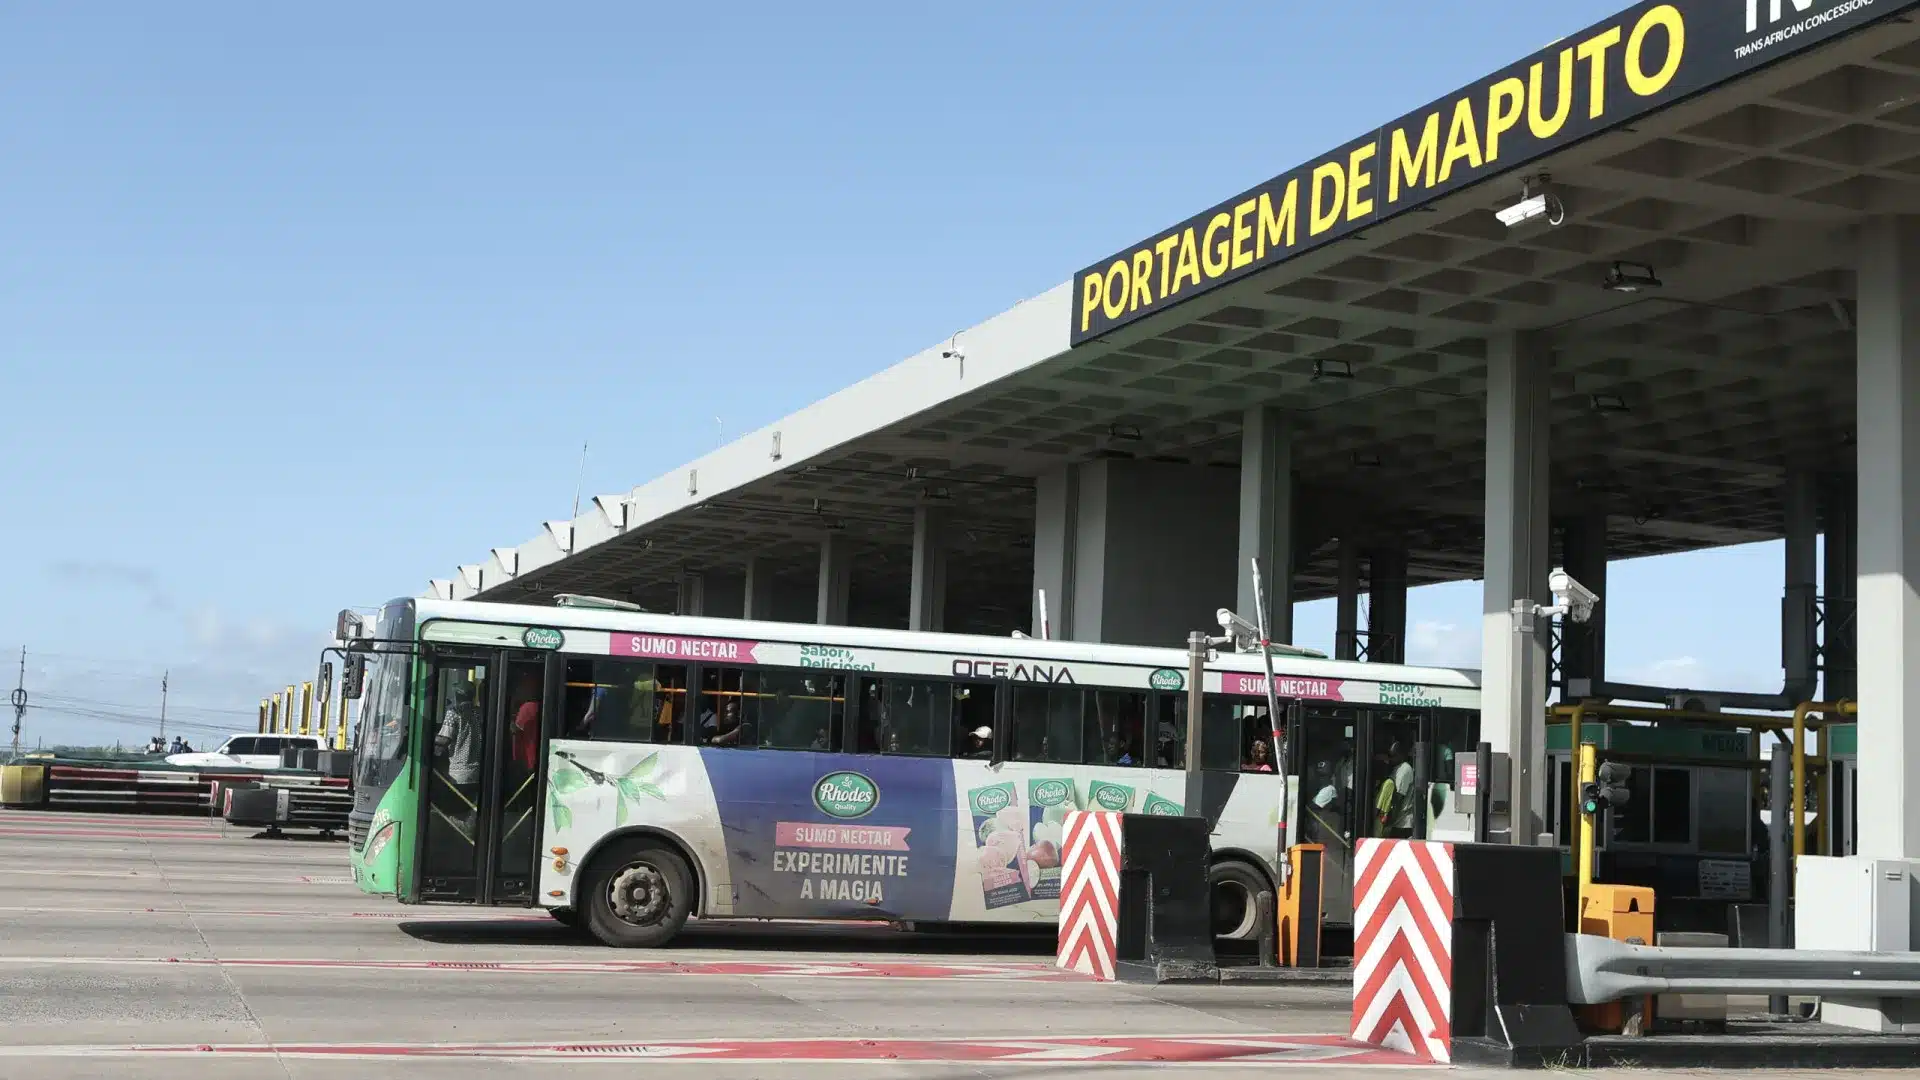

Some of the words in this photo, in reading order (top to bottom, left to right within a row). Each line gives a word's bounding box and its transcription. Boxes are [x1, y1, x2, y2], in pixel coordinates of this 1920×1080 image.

[1734, 38, 1764, 60] TRANS
[1763, 21, 1804, 48] AFRICAN
[1081, 181, 1297, 333] PORTAGEM
[1308, 142, 1376, 237] DE
[1388, 4, 1686, 203] MAPUTO
[526, 631, 560, 644] Rhodes
[631, 636, 676, 655] SUMO
[681, 640, 738, 659] NECTAR
[800, 644, 844, 658] Sabor
[800, 656, 876, 672] Delicioso!
[952, 659, 1076, 684] OCEANA
[1152, 674, 1181, 685] Rhodes
[1239, 677, 1276, 693] SUM
[1280, 680, 1328, 696] NECTAR
[1379, 682, 1416, 693] Sabor
[1379, 692, 1442, 707] Delicioso!
[820, 782, 872, 803] Rhodes
[979, 793, 1007, 806] Rhodes
[1098, 790, 1124, 804] Rhodes
[834, 803, 856, 811] Quality
[795, 827, 836, 843] SUMO
[840, 829, 892, 846] NECTAR
[773, 850, 909, 876] EXPERIMENTE
[800, 878, 814, 899] A
[819, 879, 884, 901] MAGIA
